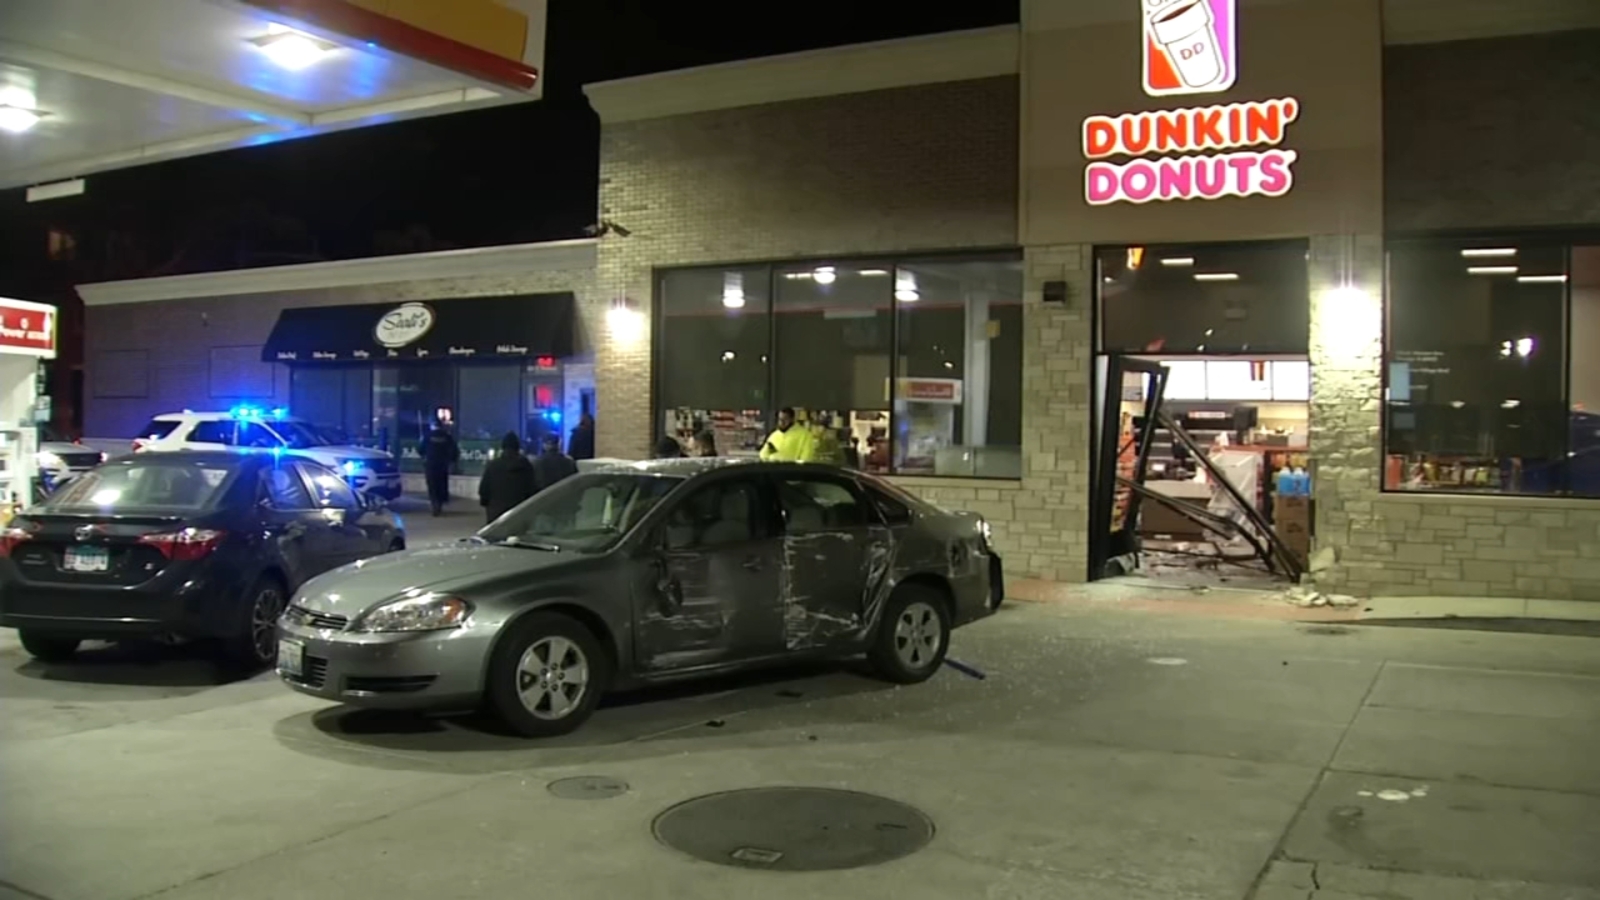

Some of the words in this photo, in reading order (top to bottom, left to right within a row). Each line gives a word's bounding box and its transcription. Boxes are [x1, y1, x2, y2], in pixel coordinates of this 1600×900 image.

[1180, 42, 1205, 60] DD
[1084, 99, 1296, 156] DUNKIN'
[1087, 153, 1289, 202] DONUTS
